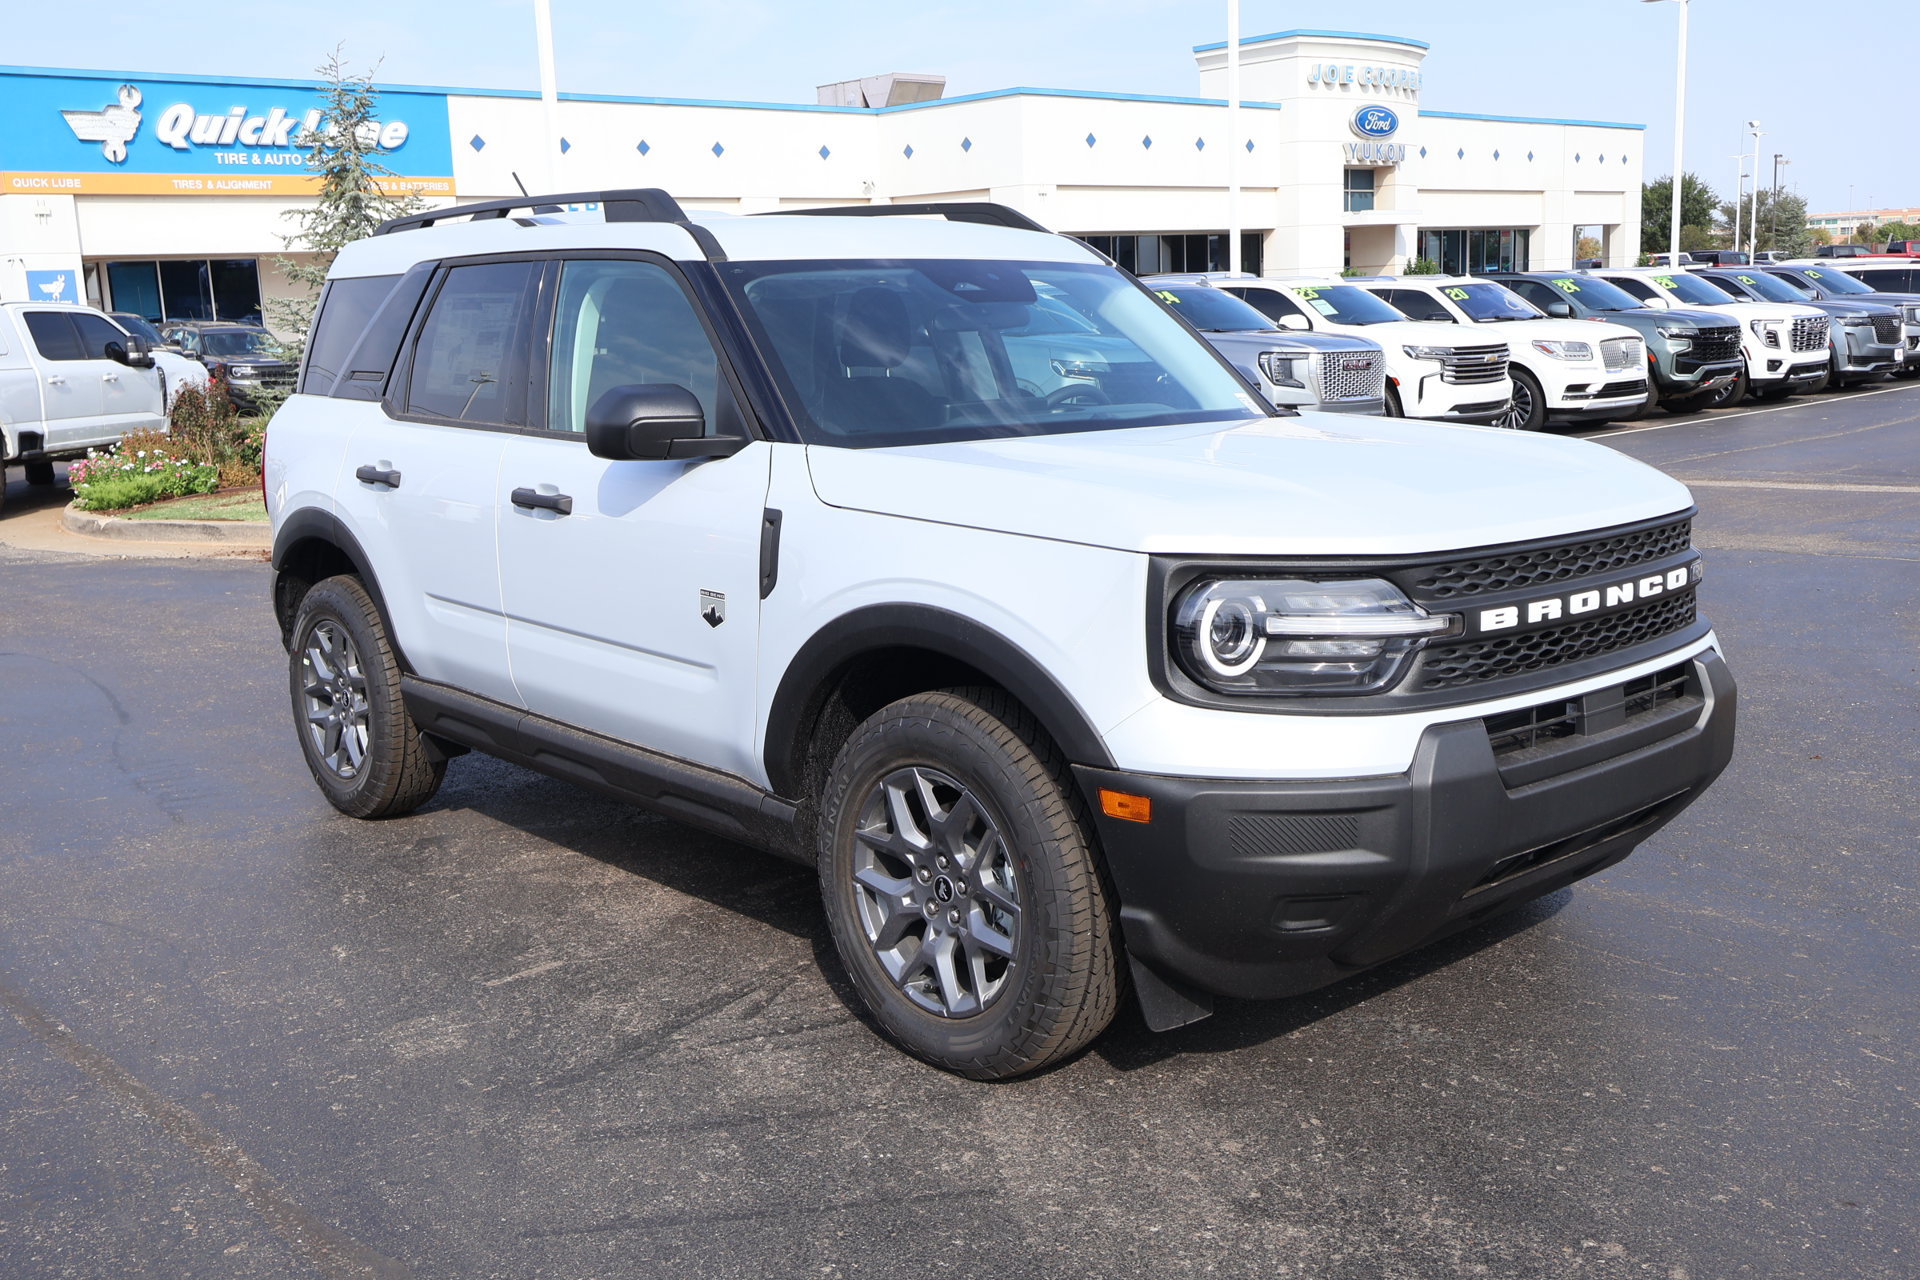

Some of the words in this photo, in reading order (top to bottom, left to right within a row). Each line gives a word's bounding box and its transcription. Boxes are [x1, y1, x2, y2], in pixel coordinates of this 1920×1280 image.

[1308, 64, 1354, 85] JOE
[1358, 67, 1423, 90] COOPER
[155, 102, 298, 149] Quick
[1364, 110, 1392, 131] Ford
[214, 152, 248, 165] TIRE
[251, 152, 261, 165] &
[264, 153, 302, 165] AUTO
[1344, 142, 1406, 161] YUKON
[12, 177, 49, 188] QUICK
[51, 178, 82, 188] LUBE
[172, 179, 203, 190] TIRES
[206, 180, 214, 190] &
[215, 180, 273, 190] ALIGNMENT
[391, 181, 398, 191] &
[400, 182, 450, 191] BATTERIES
[1444, 287, 1470, 301] 20
[1480, 567, 1688, 632] BRONCO
